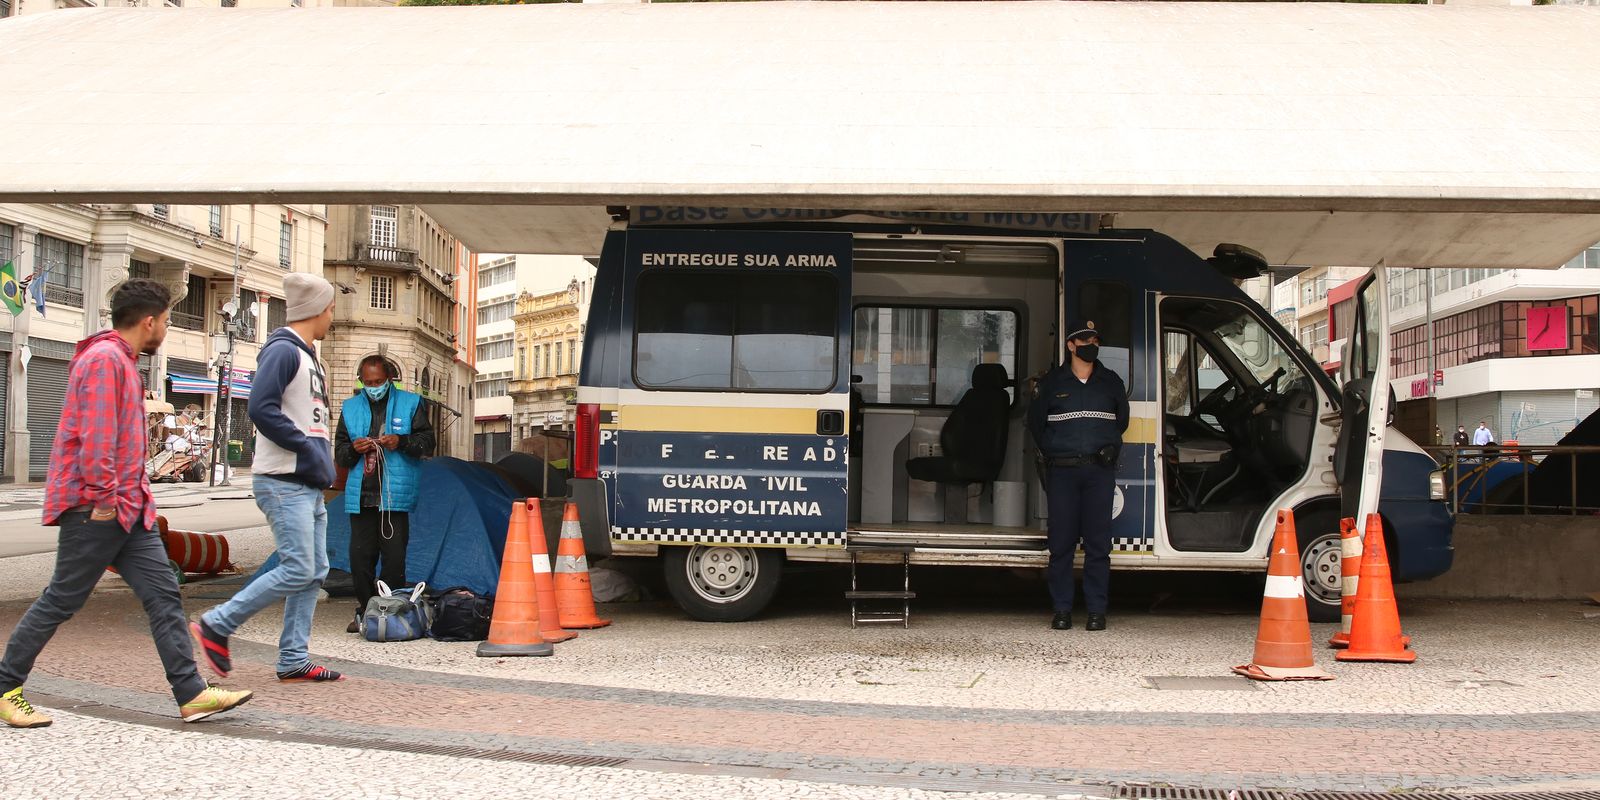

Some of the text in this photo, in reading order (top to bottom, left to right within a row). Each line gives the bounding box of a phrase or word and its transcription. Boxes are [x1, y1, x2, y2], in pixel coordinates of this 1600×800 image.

[642, 253, 837, 267] ENTREGUE SUA ARMA
[662, 474, 747, 490] GUARDA
[648, 498, 822, 517] METROPOLITANA
